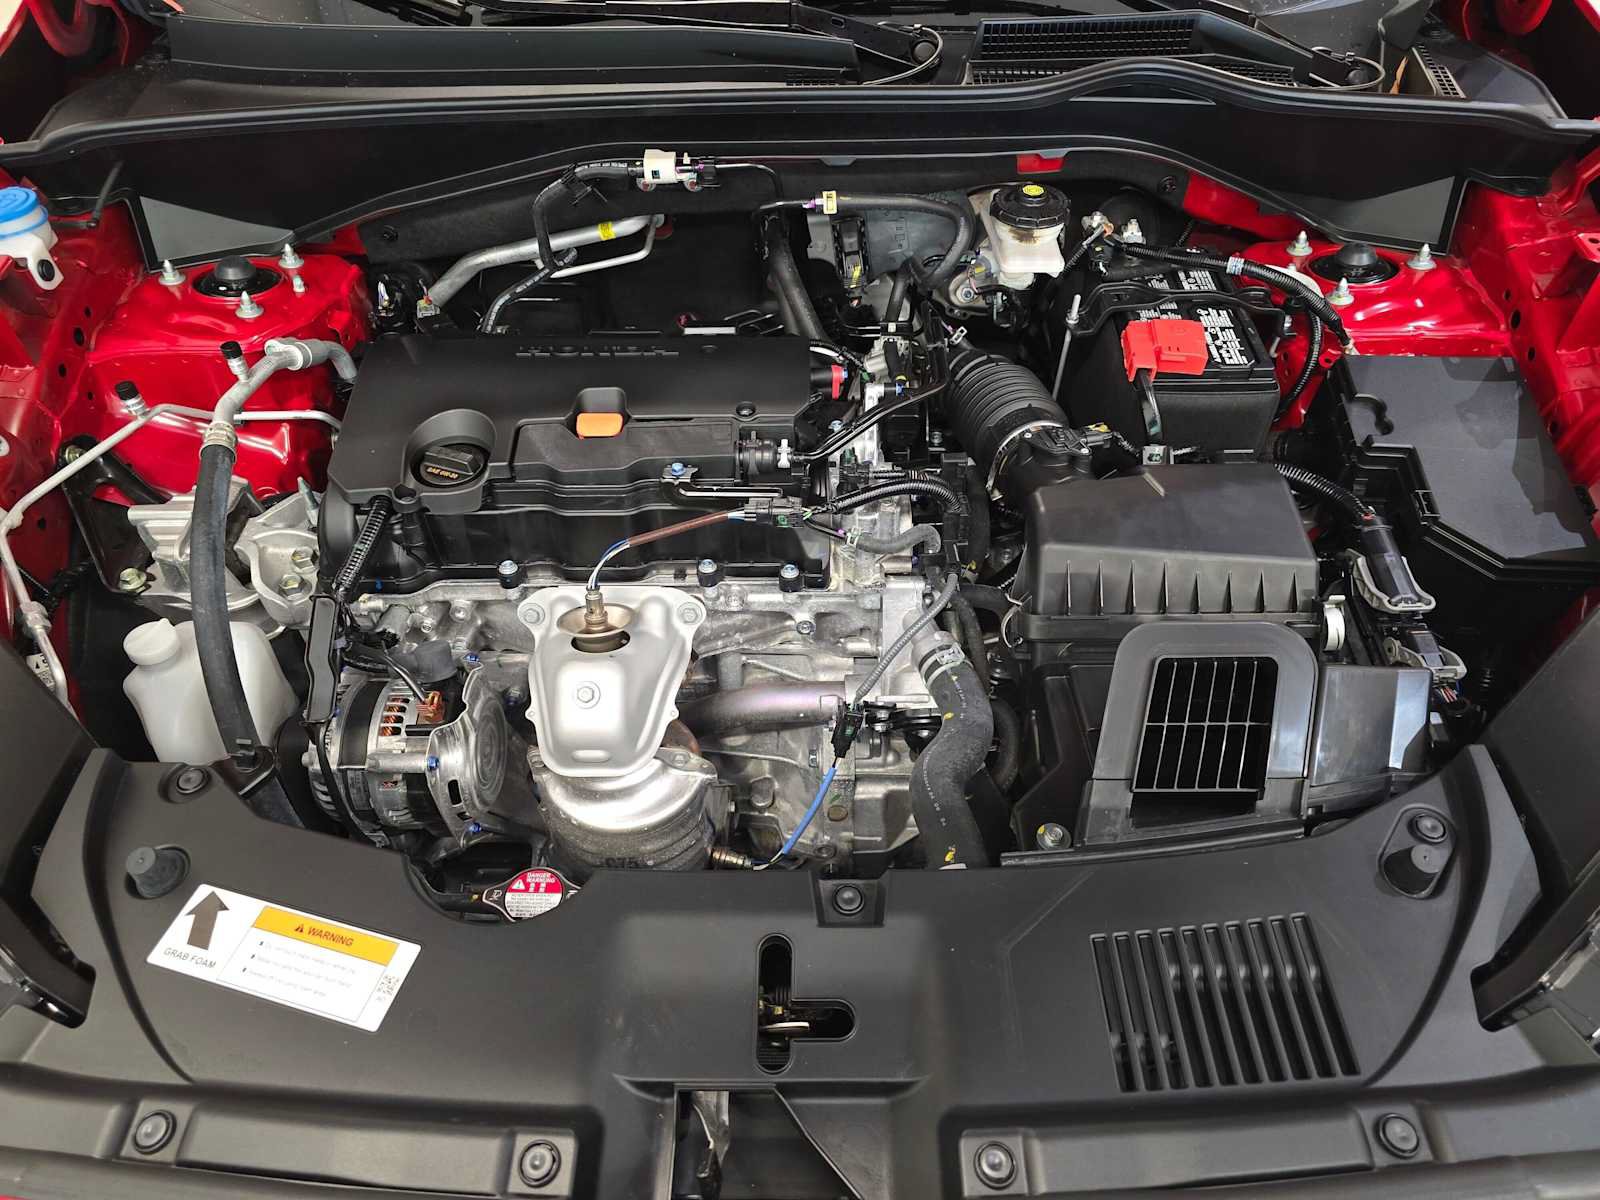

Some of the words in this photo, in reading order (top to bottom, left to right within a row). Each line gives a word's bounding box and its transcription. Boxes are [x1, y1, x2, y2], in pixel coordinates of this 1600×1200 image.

[306, 926, 355, 948] WARNING
[162, 946, 189, 963] GRAB
[189, 953, 217, 970] FOAM
